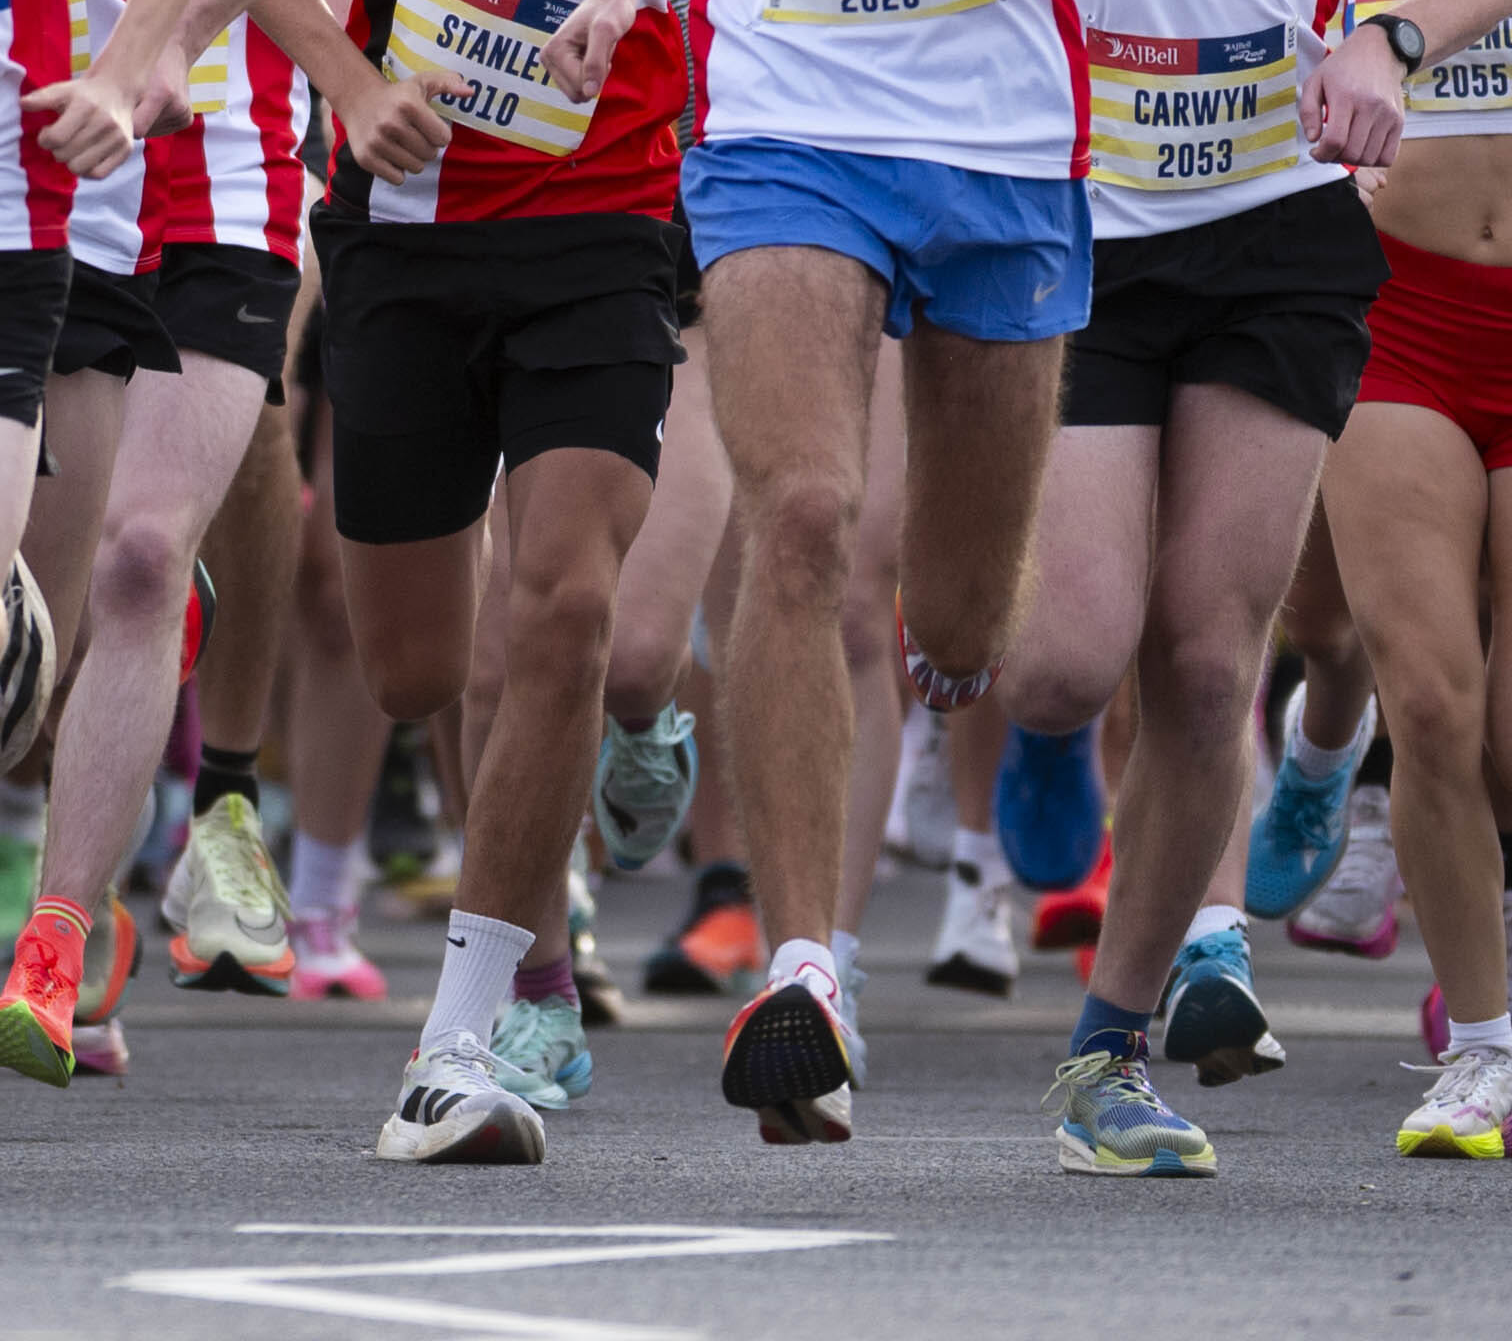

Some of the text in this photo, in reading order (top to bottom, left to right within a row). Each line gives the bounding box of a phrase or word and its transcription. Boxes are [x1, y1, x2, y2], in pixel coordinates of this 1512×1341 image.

[1123, 44, 1179, 66] AJBell
[1432, 63, 1509, 99] 2055
[1134, 83, 1258, 127] CARWYN
[1157, 138, 1233, 178] 2053
